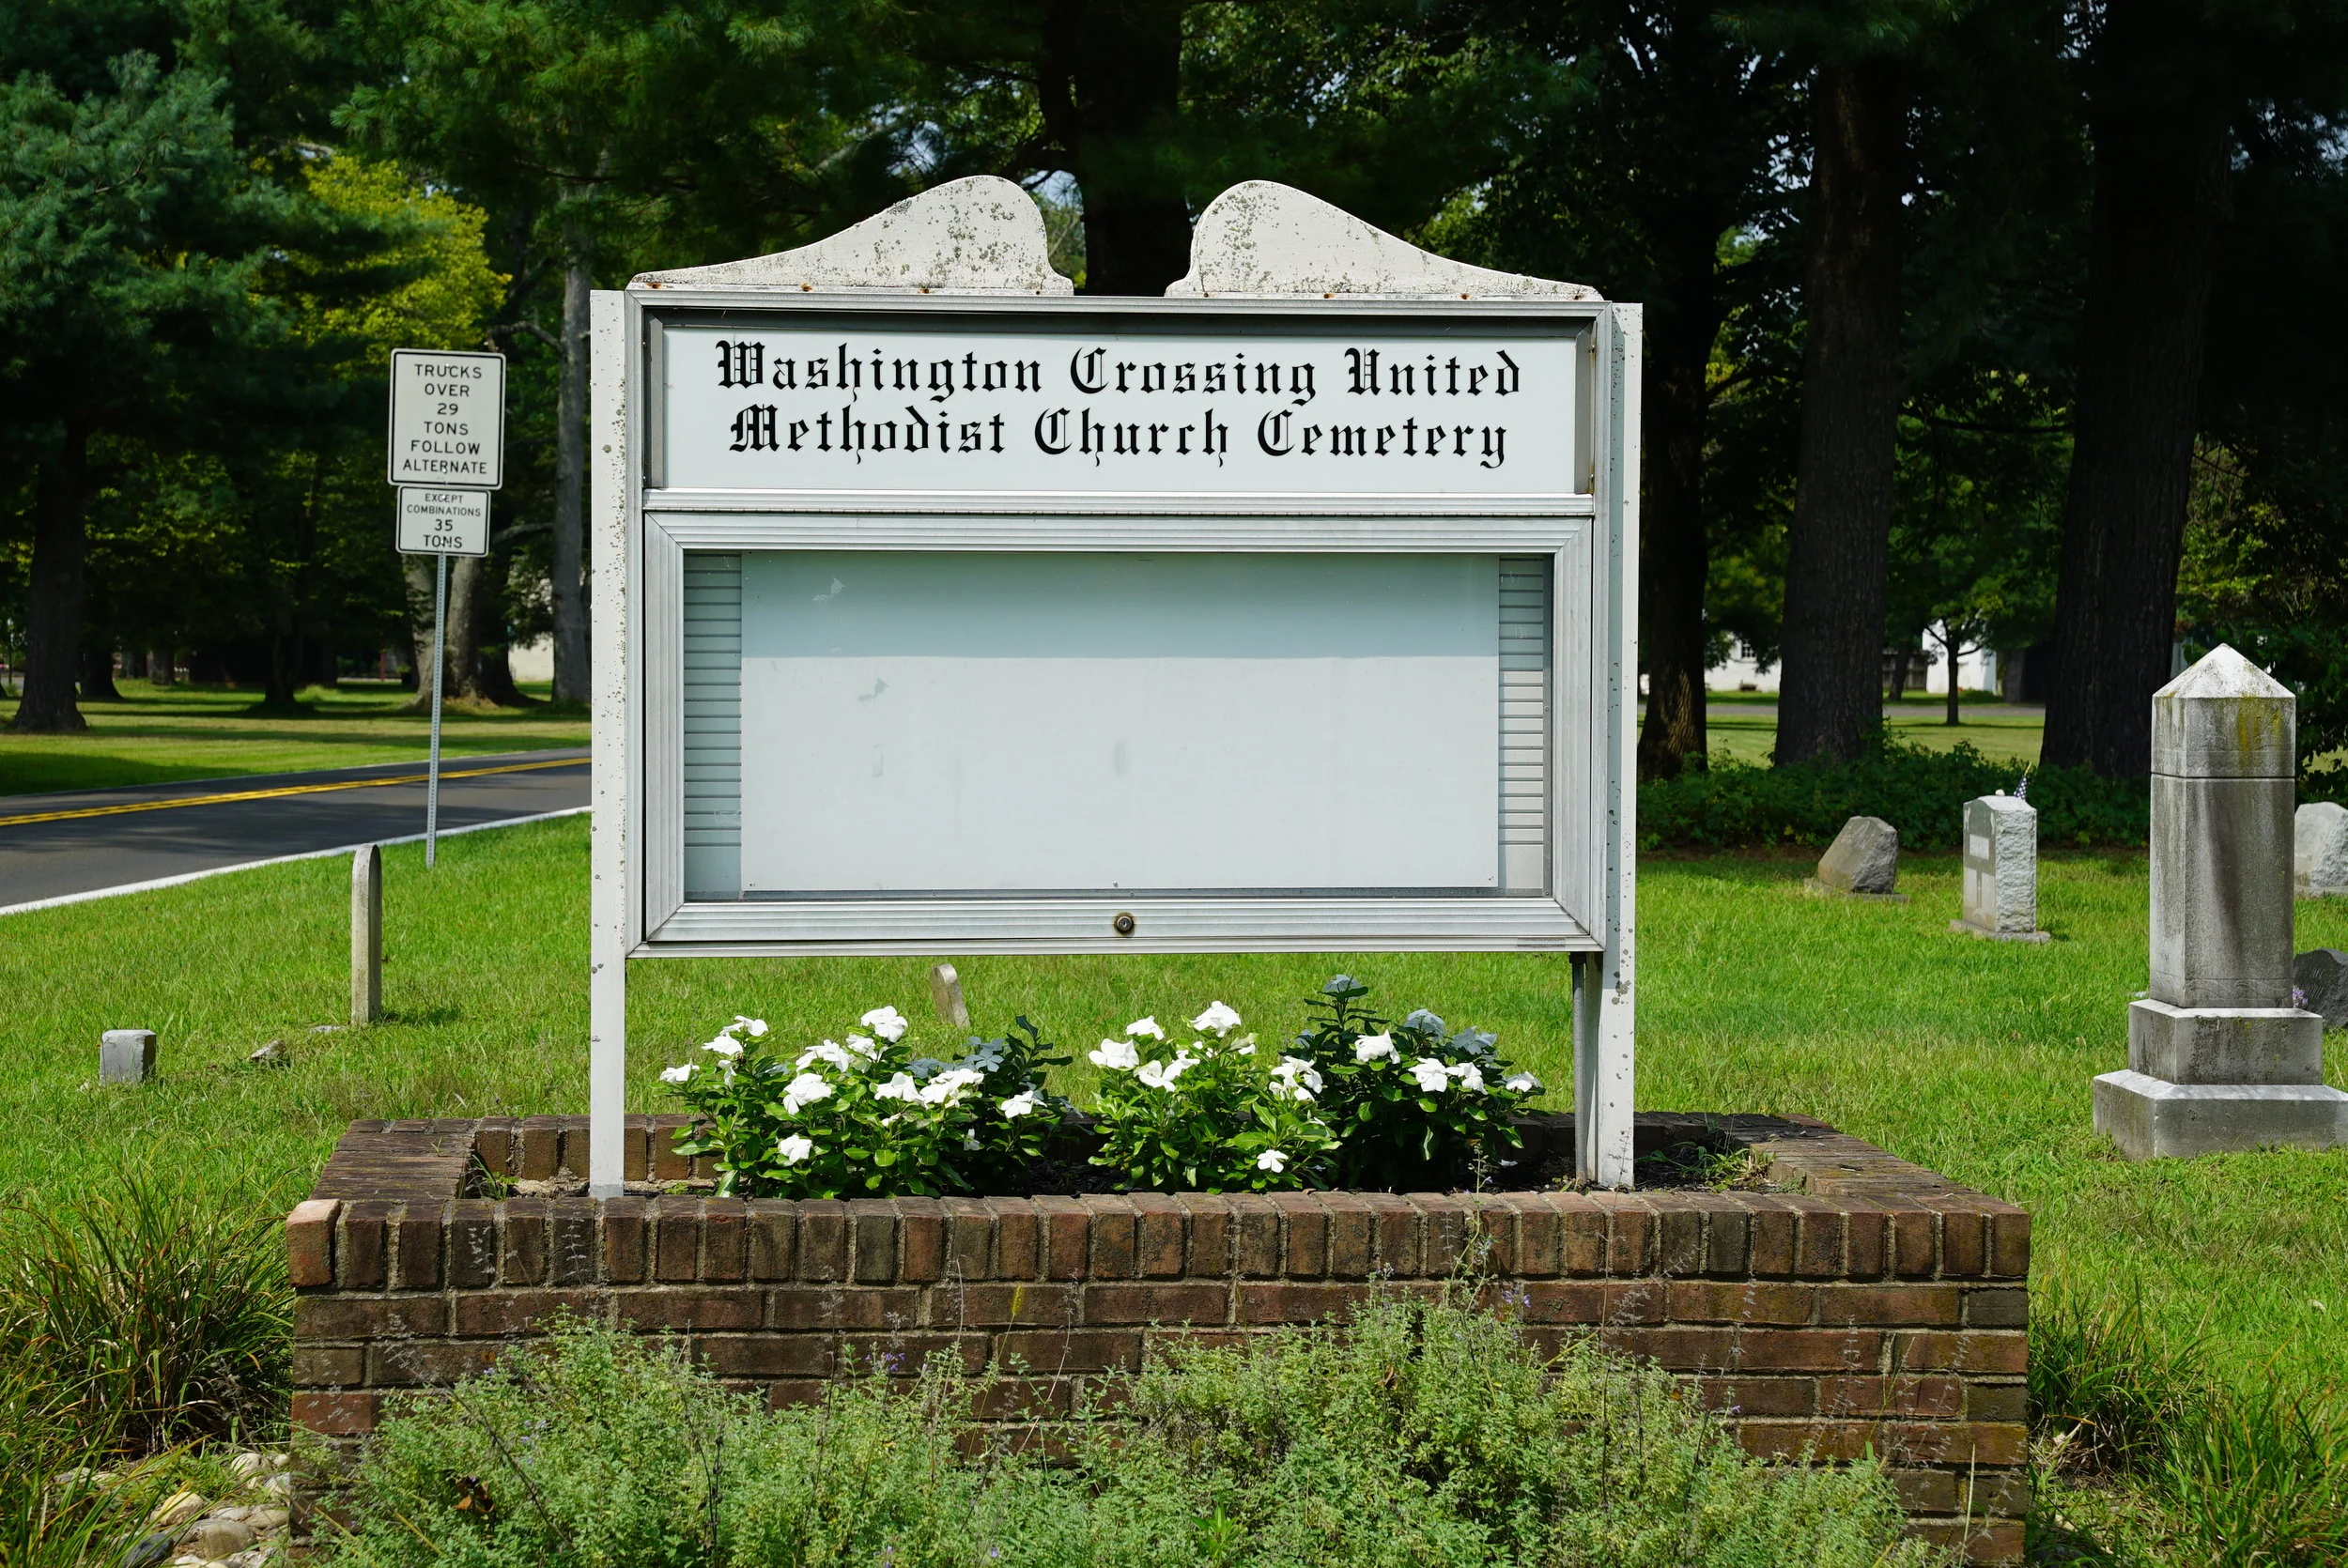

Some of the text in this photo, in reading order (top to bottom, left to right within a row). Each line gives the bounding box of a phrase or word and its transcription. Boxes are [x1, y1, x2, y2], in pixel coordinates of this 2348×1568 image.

[414, 363, 482, 379] TRUCKS
[716, 340, 1520, 406] Washington Crossing United
[425, 383, 470, 397] OVER
[437, 403, 458, 415] 29
[424, 422, 469, 436] TONS
[729, 404, 1506, 469] Methodist Church Cemetery
[410, 440, 480, 455] FOLLOW
[403, 459, 487, 474] ALTERNATE
[425, 493, 464, 503] EXCEPT
[407, 504, 481, 516] COMBINATIONS
[434, 519, 453, 531] 35
[423, 535, 462, 548] TONS
